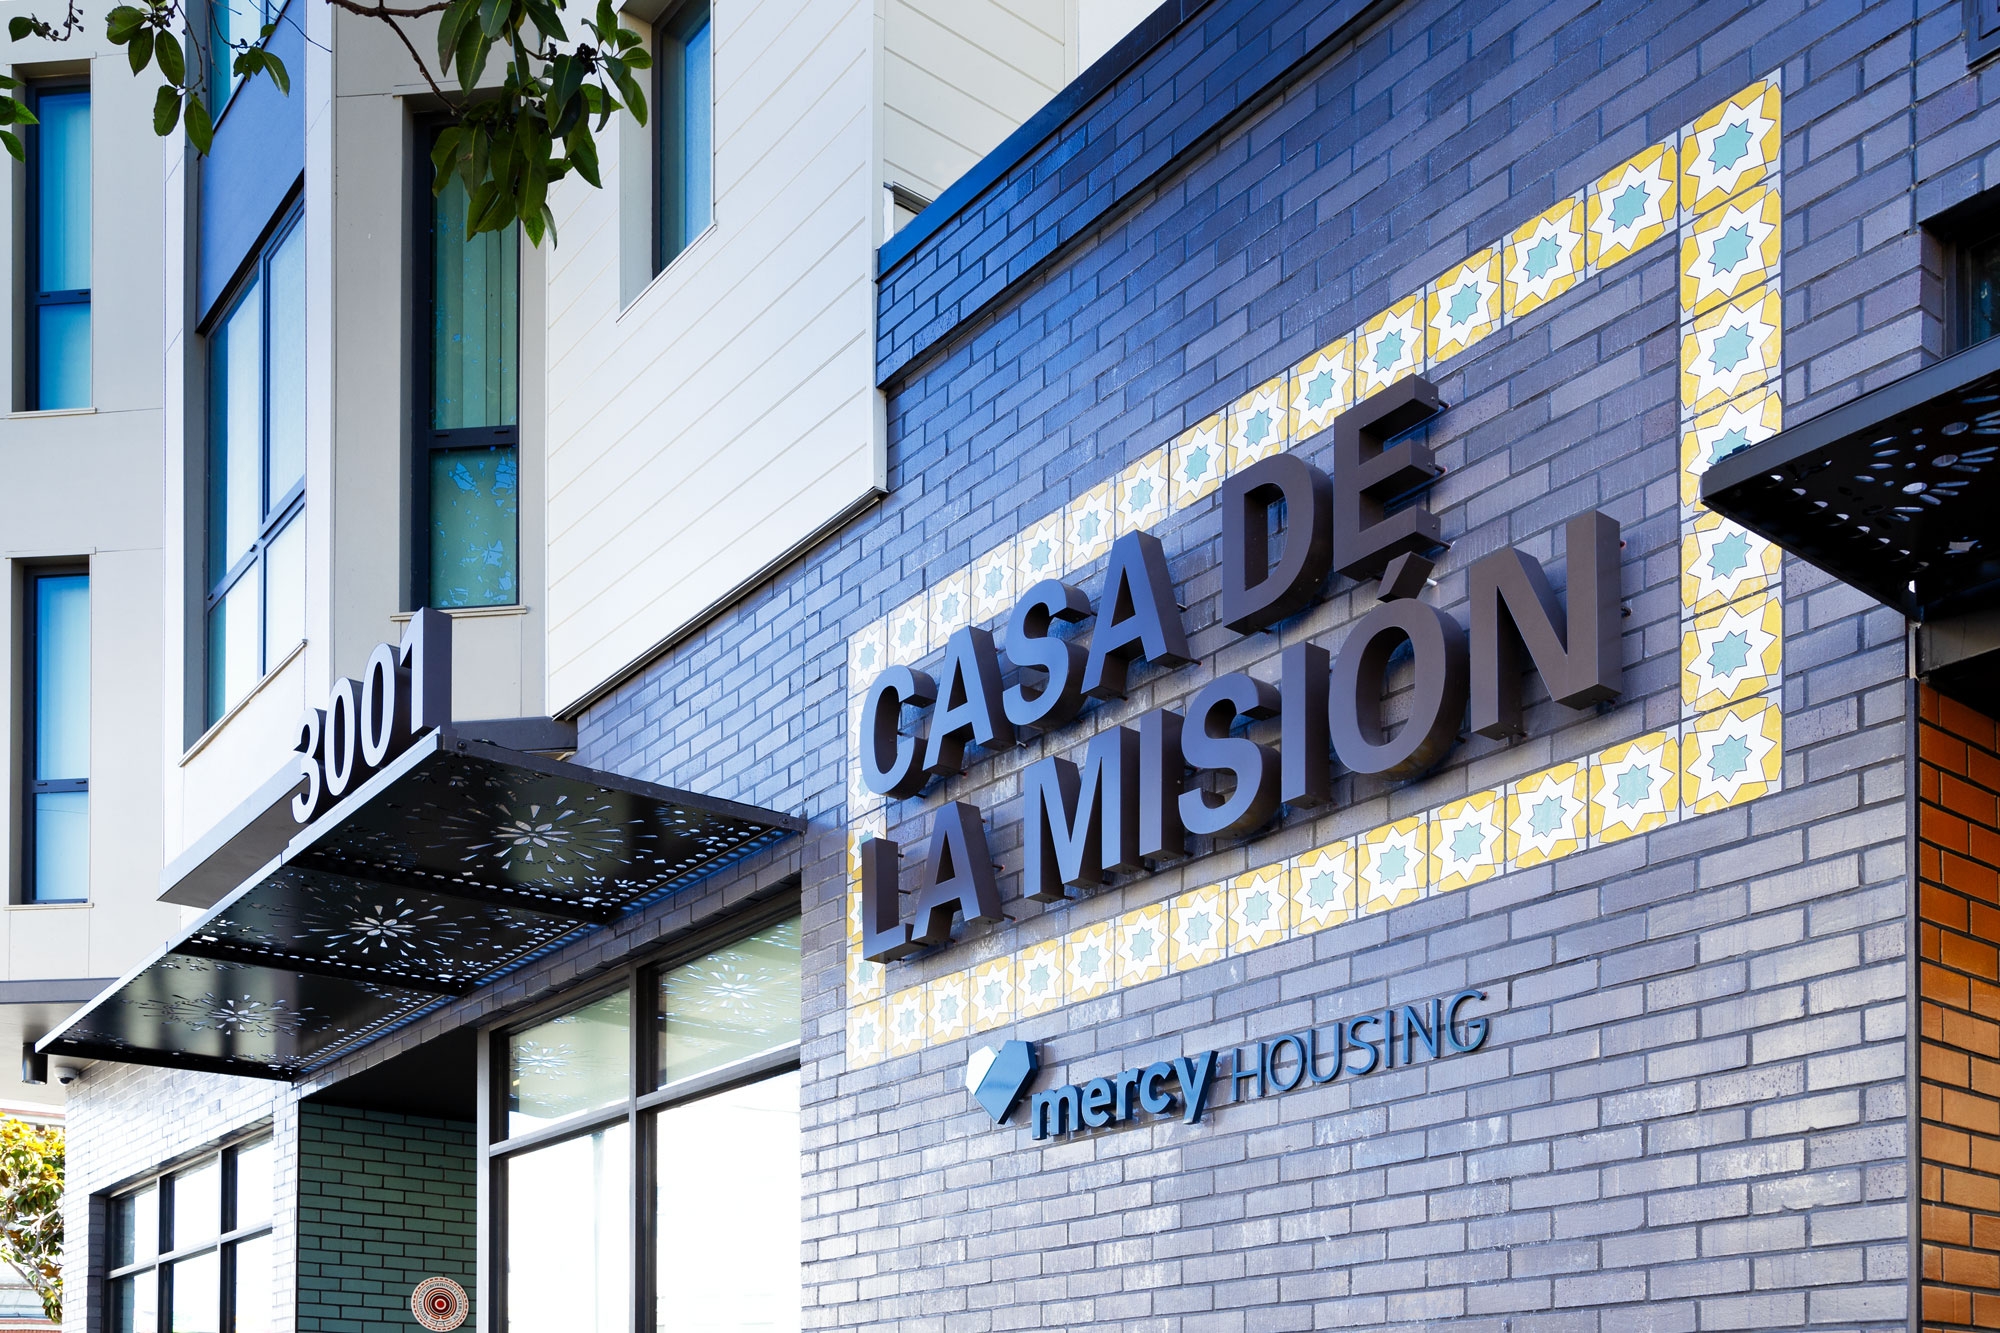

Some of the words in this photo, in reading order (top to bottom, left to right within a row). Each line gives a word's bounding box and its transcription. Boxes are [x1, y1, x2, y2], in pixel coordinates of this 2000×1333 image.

[291, 606, 437, 823] 3001
[860, 529, 1190, 797] CASA
[1222, 374, 1440, 636] DE
[862, 801, 1003, 963] LA
[1024, 510, 1621, 903] MISIÓN
[1031, 1050, 1219, 1140] mercy
[1232, 990, 1488, 1101] HOUSING
